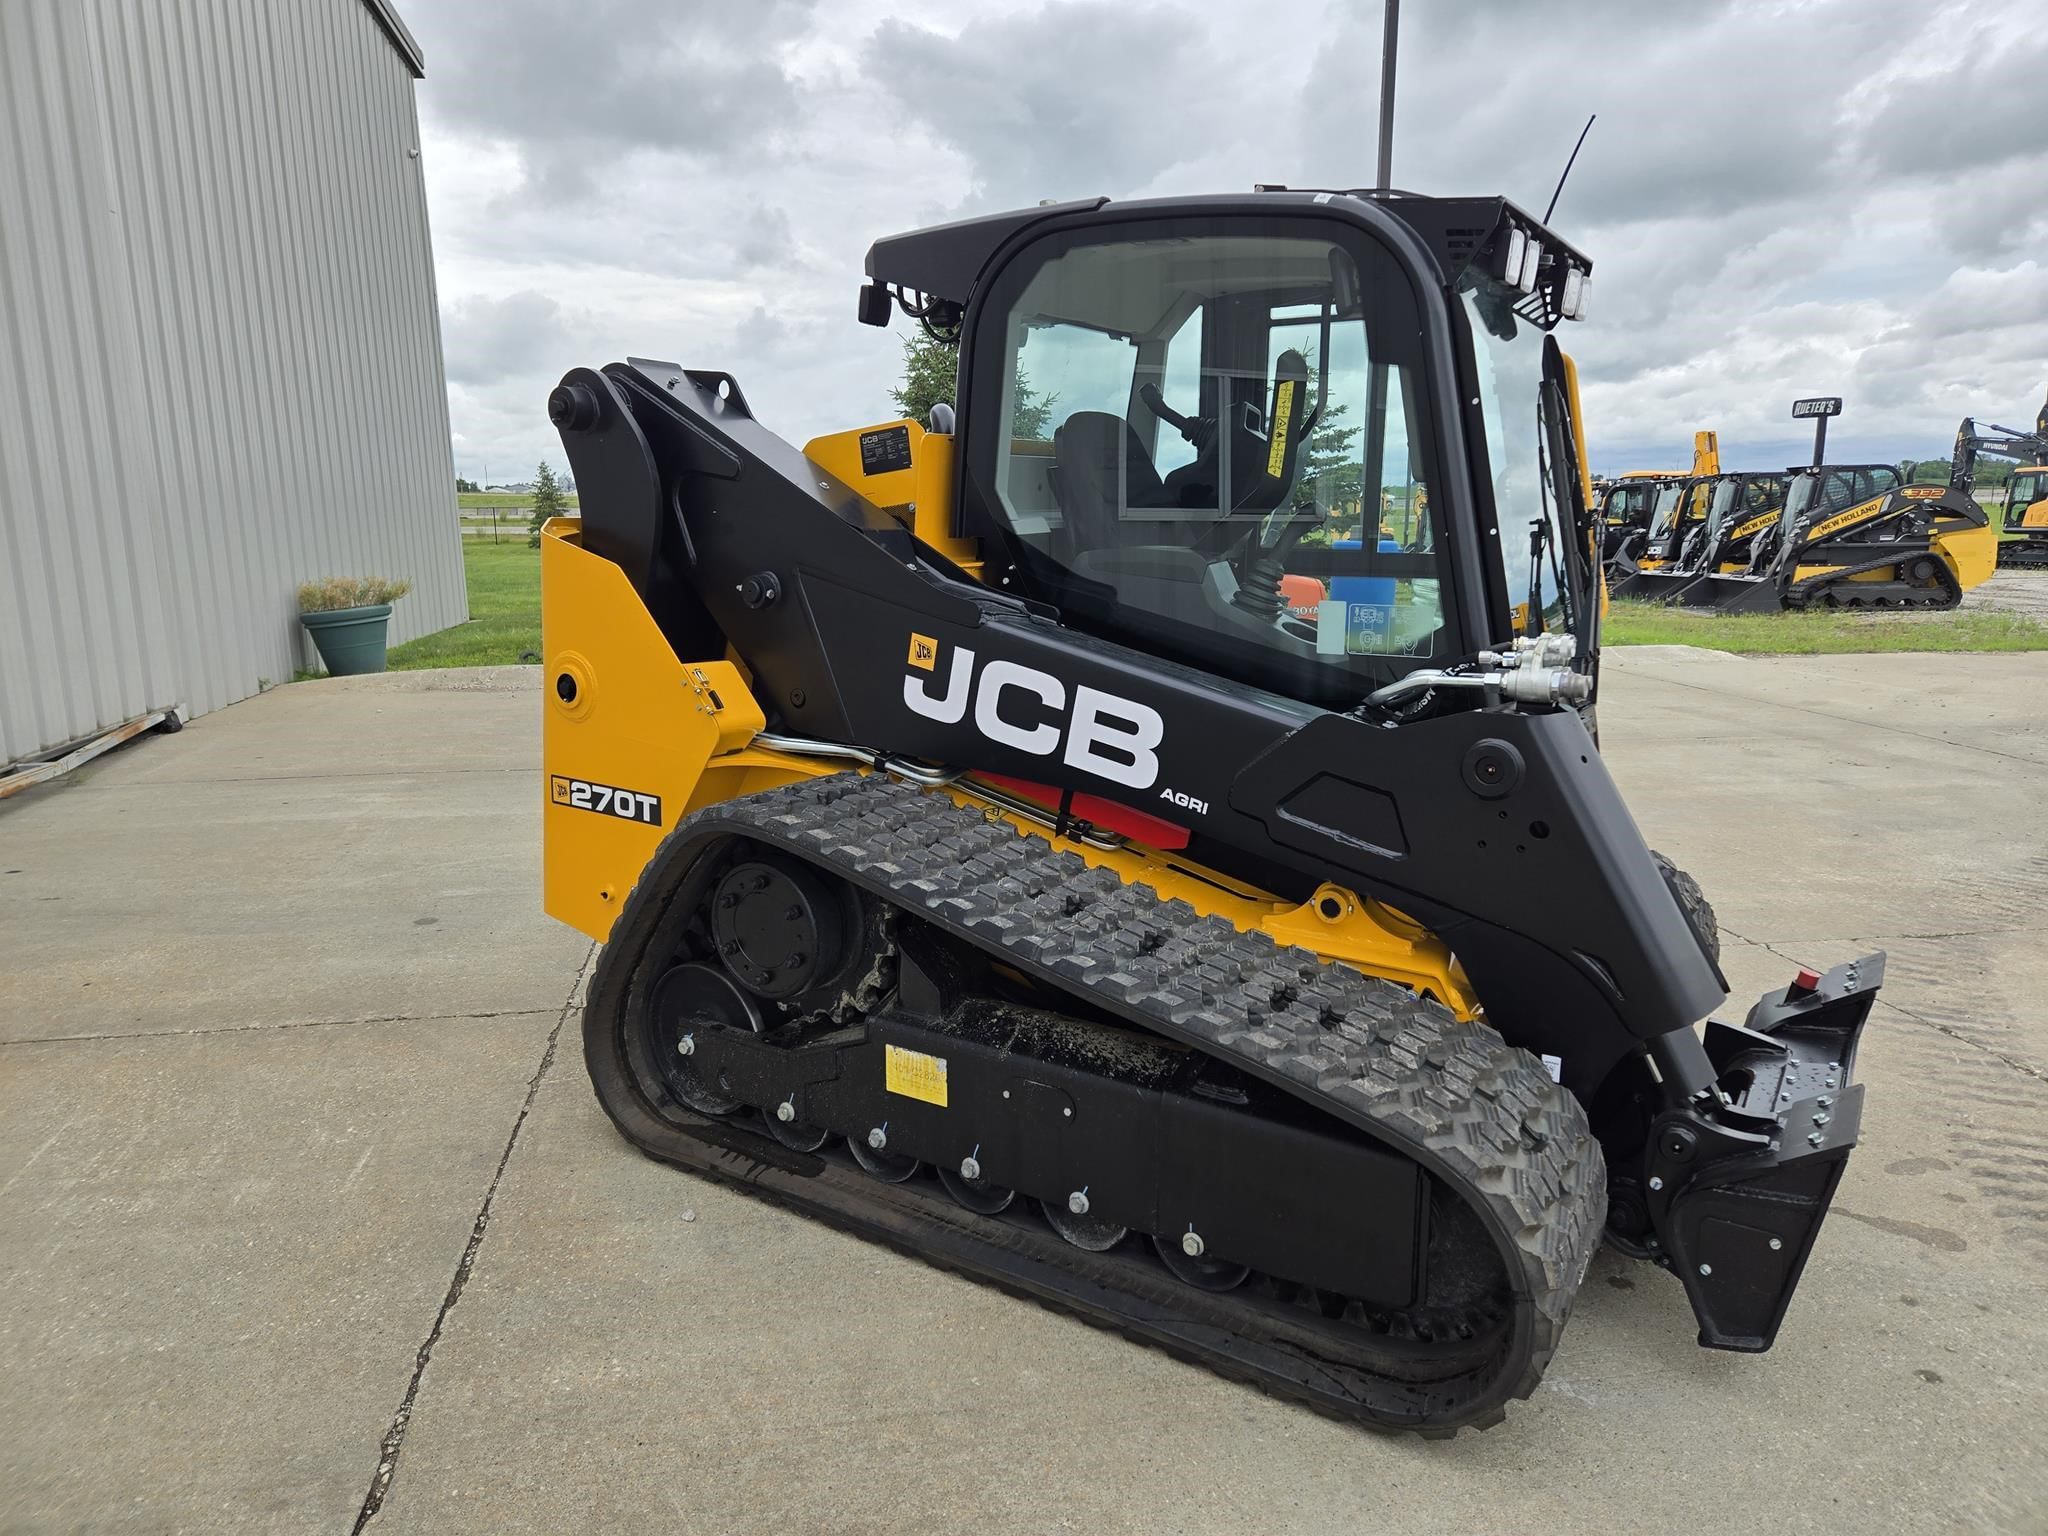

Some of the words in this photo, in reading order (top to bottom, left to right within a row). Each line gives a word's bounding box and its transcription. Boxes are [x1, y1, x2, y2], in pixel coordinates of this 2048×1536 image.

[1794, 400, 1835, 416] RUETER'S
[862, 435, 879, 445] JCB
[1983, 442, 2009, 451] HYUNDAI
[1742, 522, 1758, 533] NEW
[1759, 511, 1782, 526] HOLLA
[1821, 519, 1840, 531] NEW
[1841, 503, 1878, 523] HOLLAND
[916, 642, 932, 659] JCB
[903, 646, 1164, 790] JCB
[570, 781, 658, 822] 270T
[1160, 787, 1209, 816] AGRI
